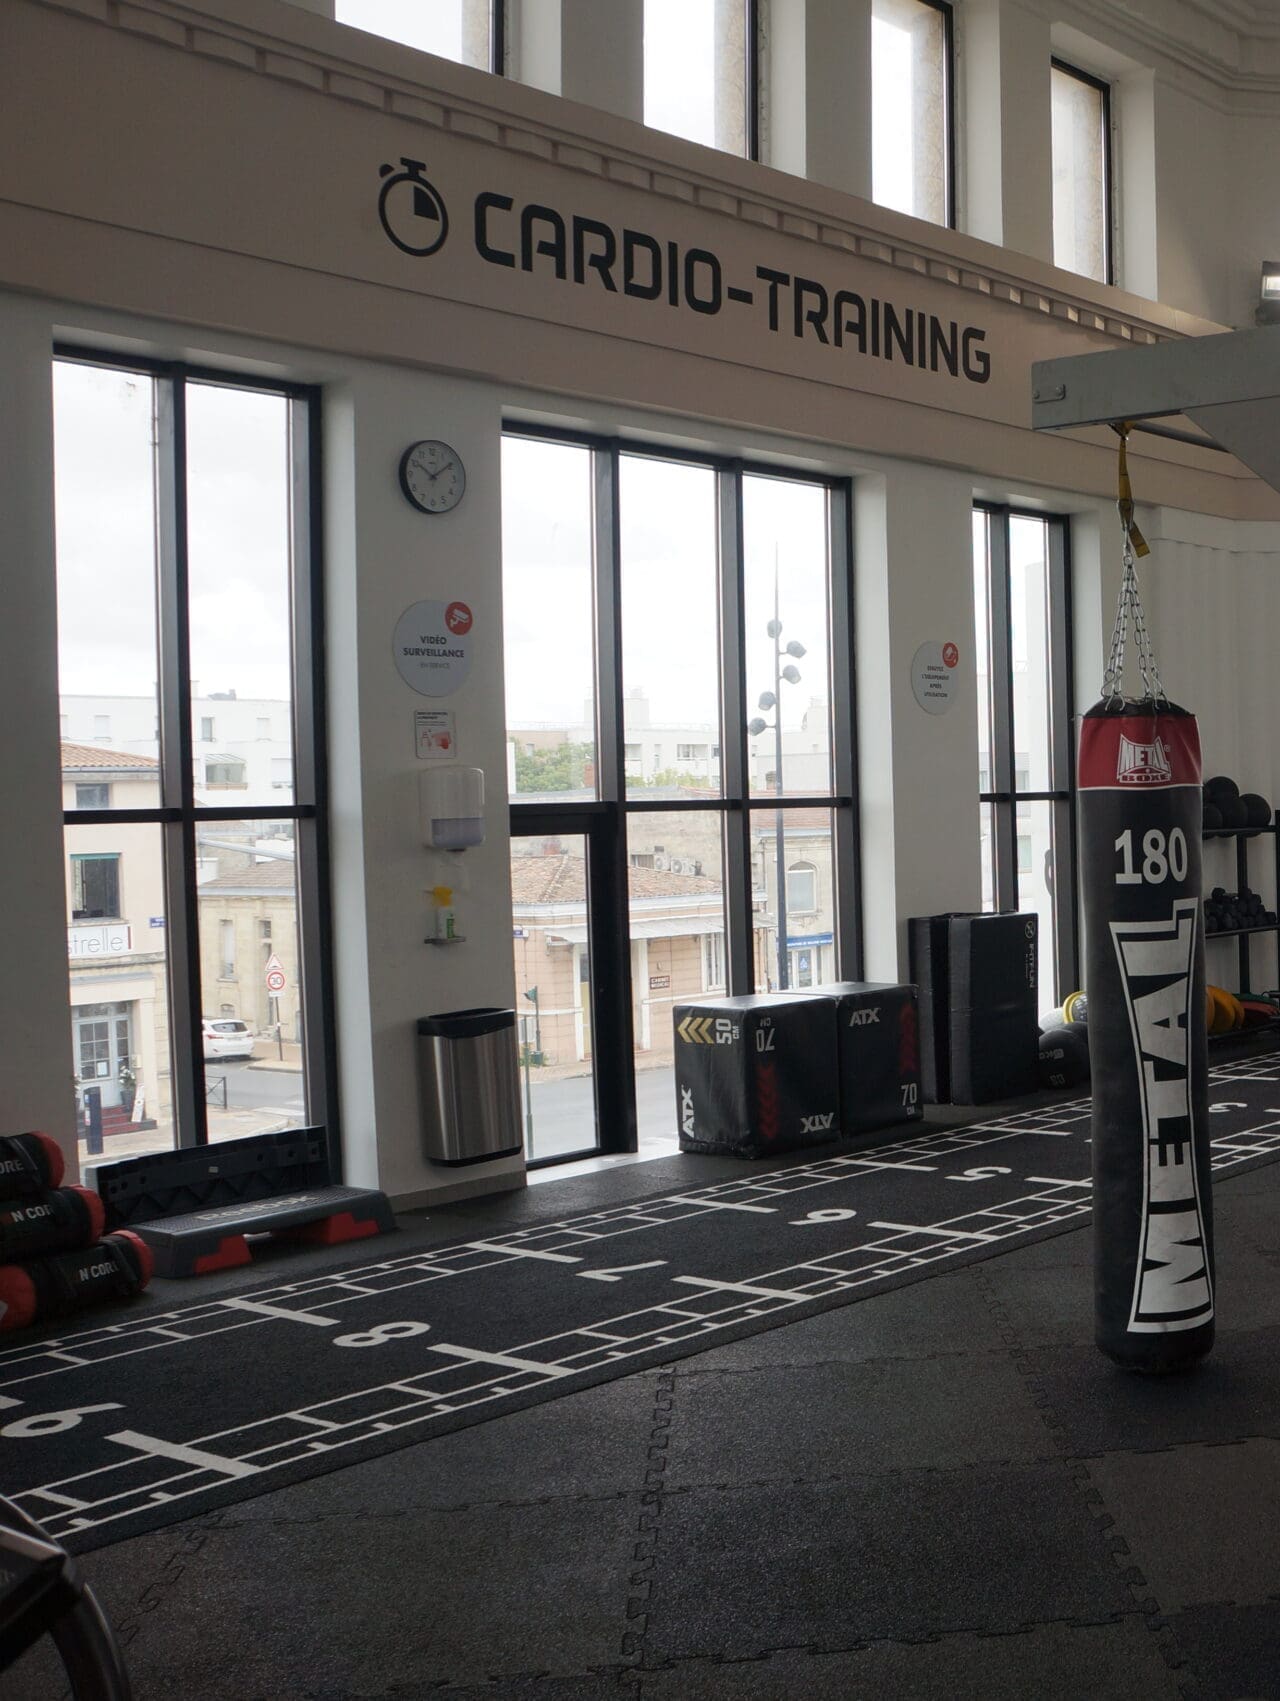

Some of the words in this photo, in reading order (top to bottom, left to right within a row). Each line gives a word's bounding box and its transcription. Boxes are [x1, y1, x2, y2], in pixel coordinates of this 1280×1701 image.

[475, 191, 991, 384] CARDIO-TRAINING
[403, 647, 465, 658] SURVEILLANCE
[420, 635, 447, 645] VIDÉO
[1120, 738, 1170, 775] METAL
[1115, 827, 1188, 884] 180
[849, 1007, 881, 1027] ATX
[715, 1018, 732, 1045] 50
[756, 1028, 775, 1052] 70
[900, 1083, 918, 1106] 70
[681, 1085, 695, 1139] ATX
[800, 1112, 834, 1134] ATX
[1110, 898, 1213, 1332] METAL
[944, 1166, 1012, 1182] 5
[332, 1321, 431, 1348] 8
